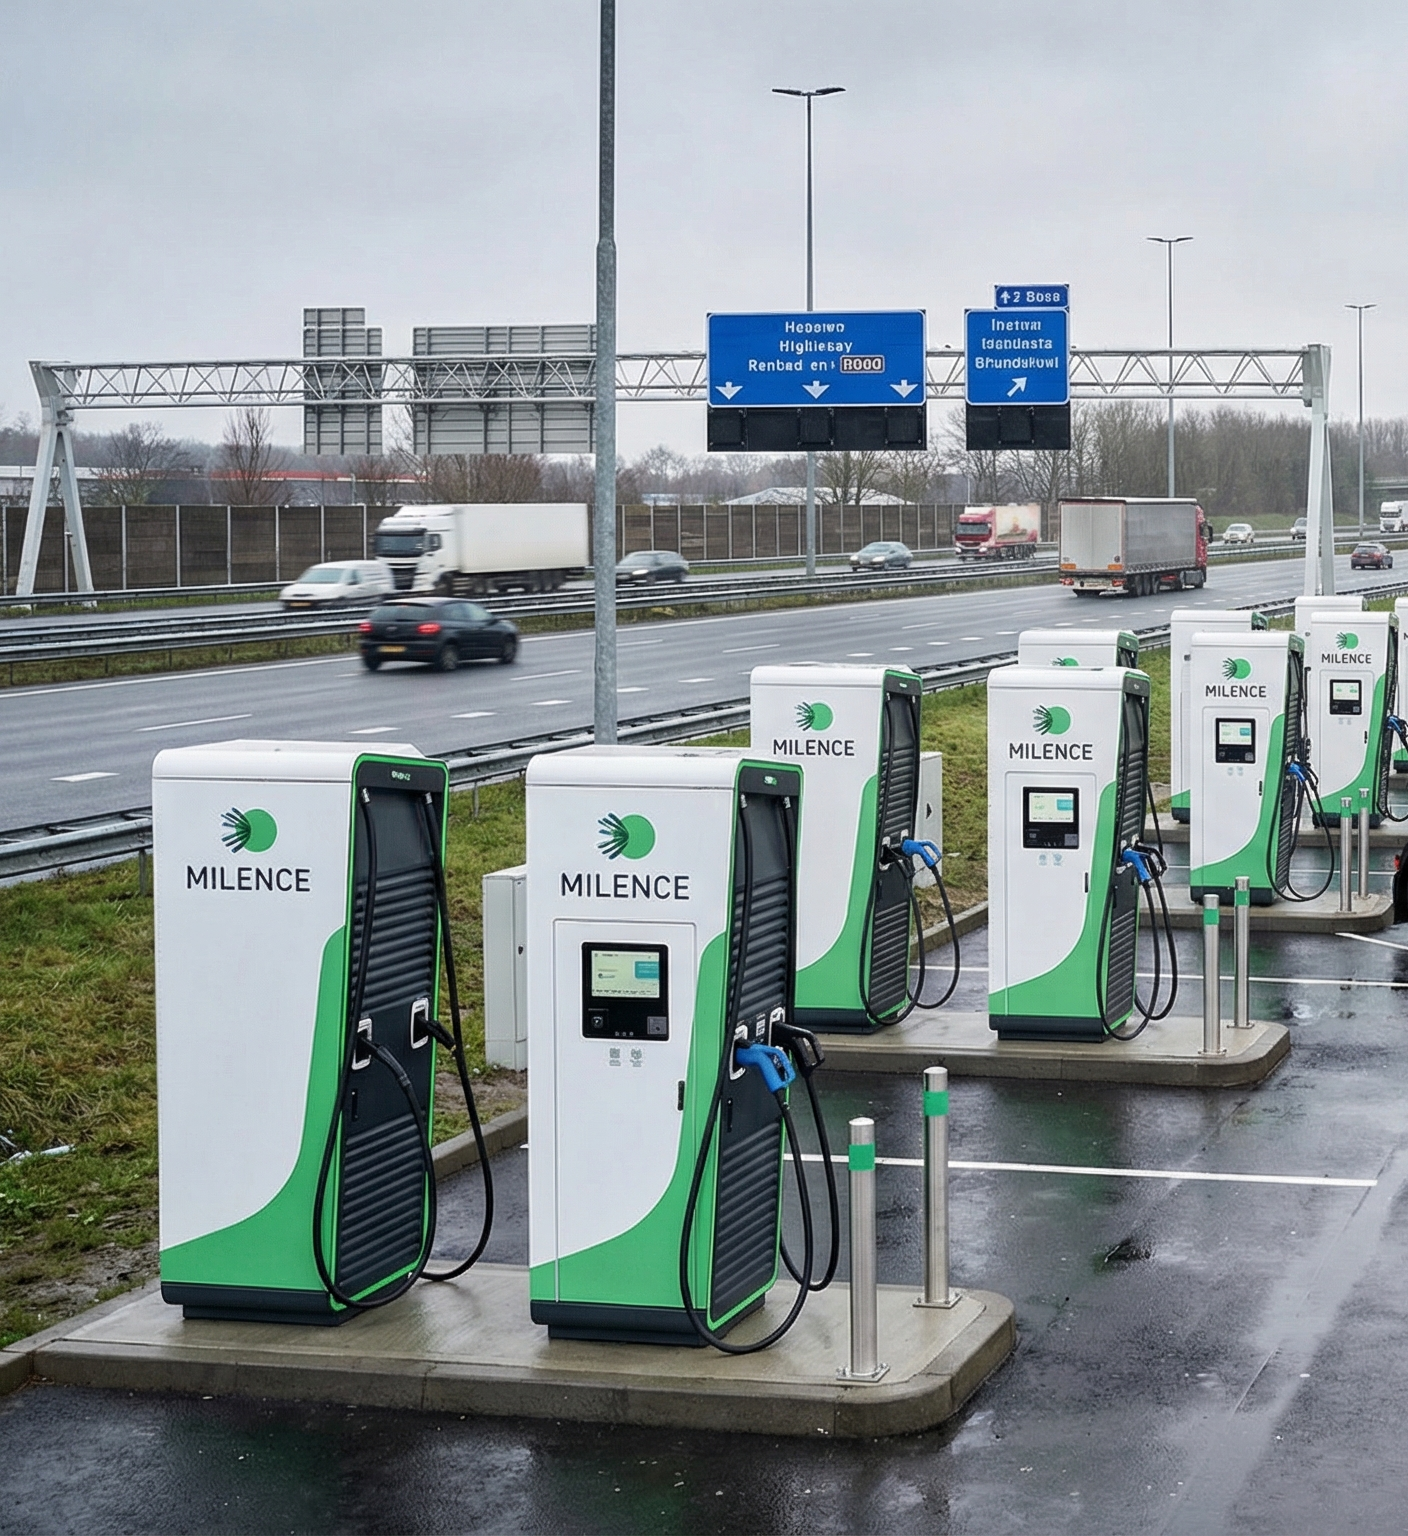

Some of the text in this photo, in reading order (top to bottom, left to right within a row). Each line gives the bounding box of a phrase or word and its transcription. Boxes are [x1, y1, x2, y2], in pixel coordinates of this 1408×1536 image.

[1321, 653, 1372, 664] MILENCE
[1205, 684, 1267, 698] MILENCE
[772, 739, 855, 758] MILENCE
[1009, 742, 1093, 761] MILENCE
[186, 865, 311, 892] MILENCE
[561, 872, 690, 900] MILENCE
